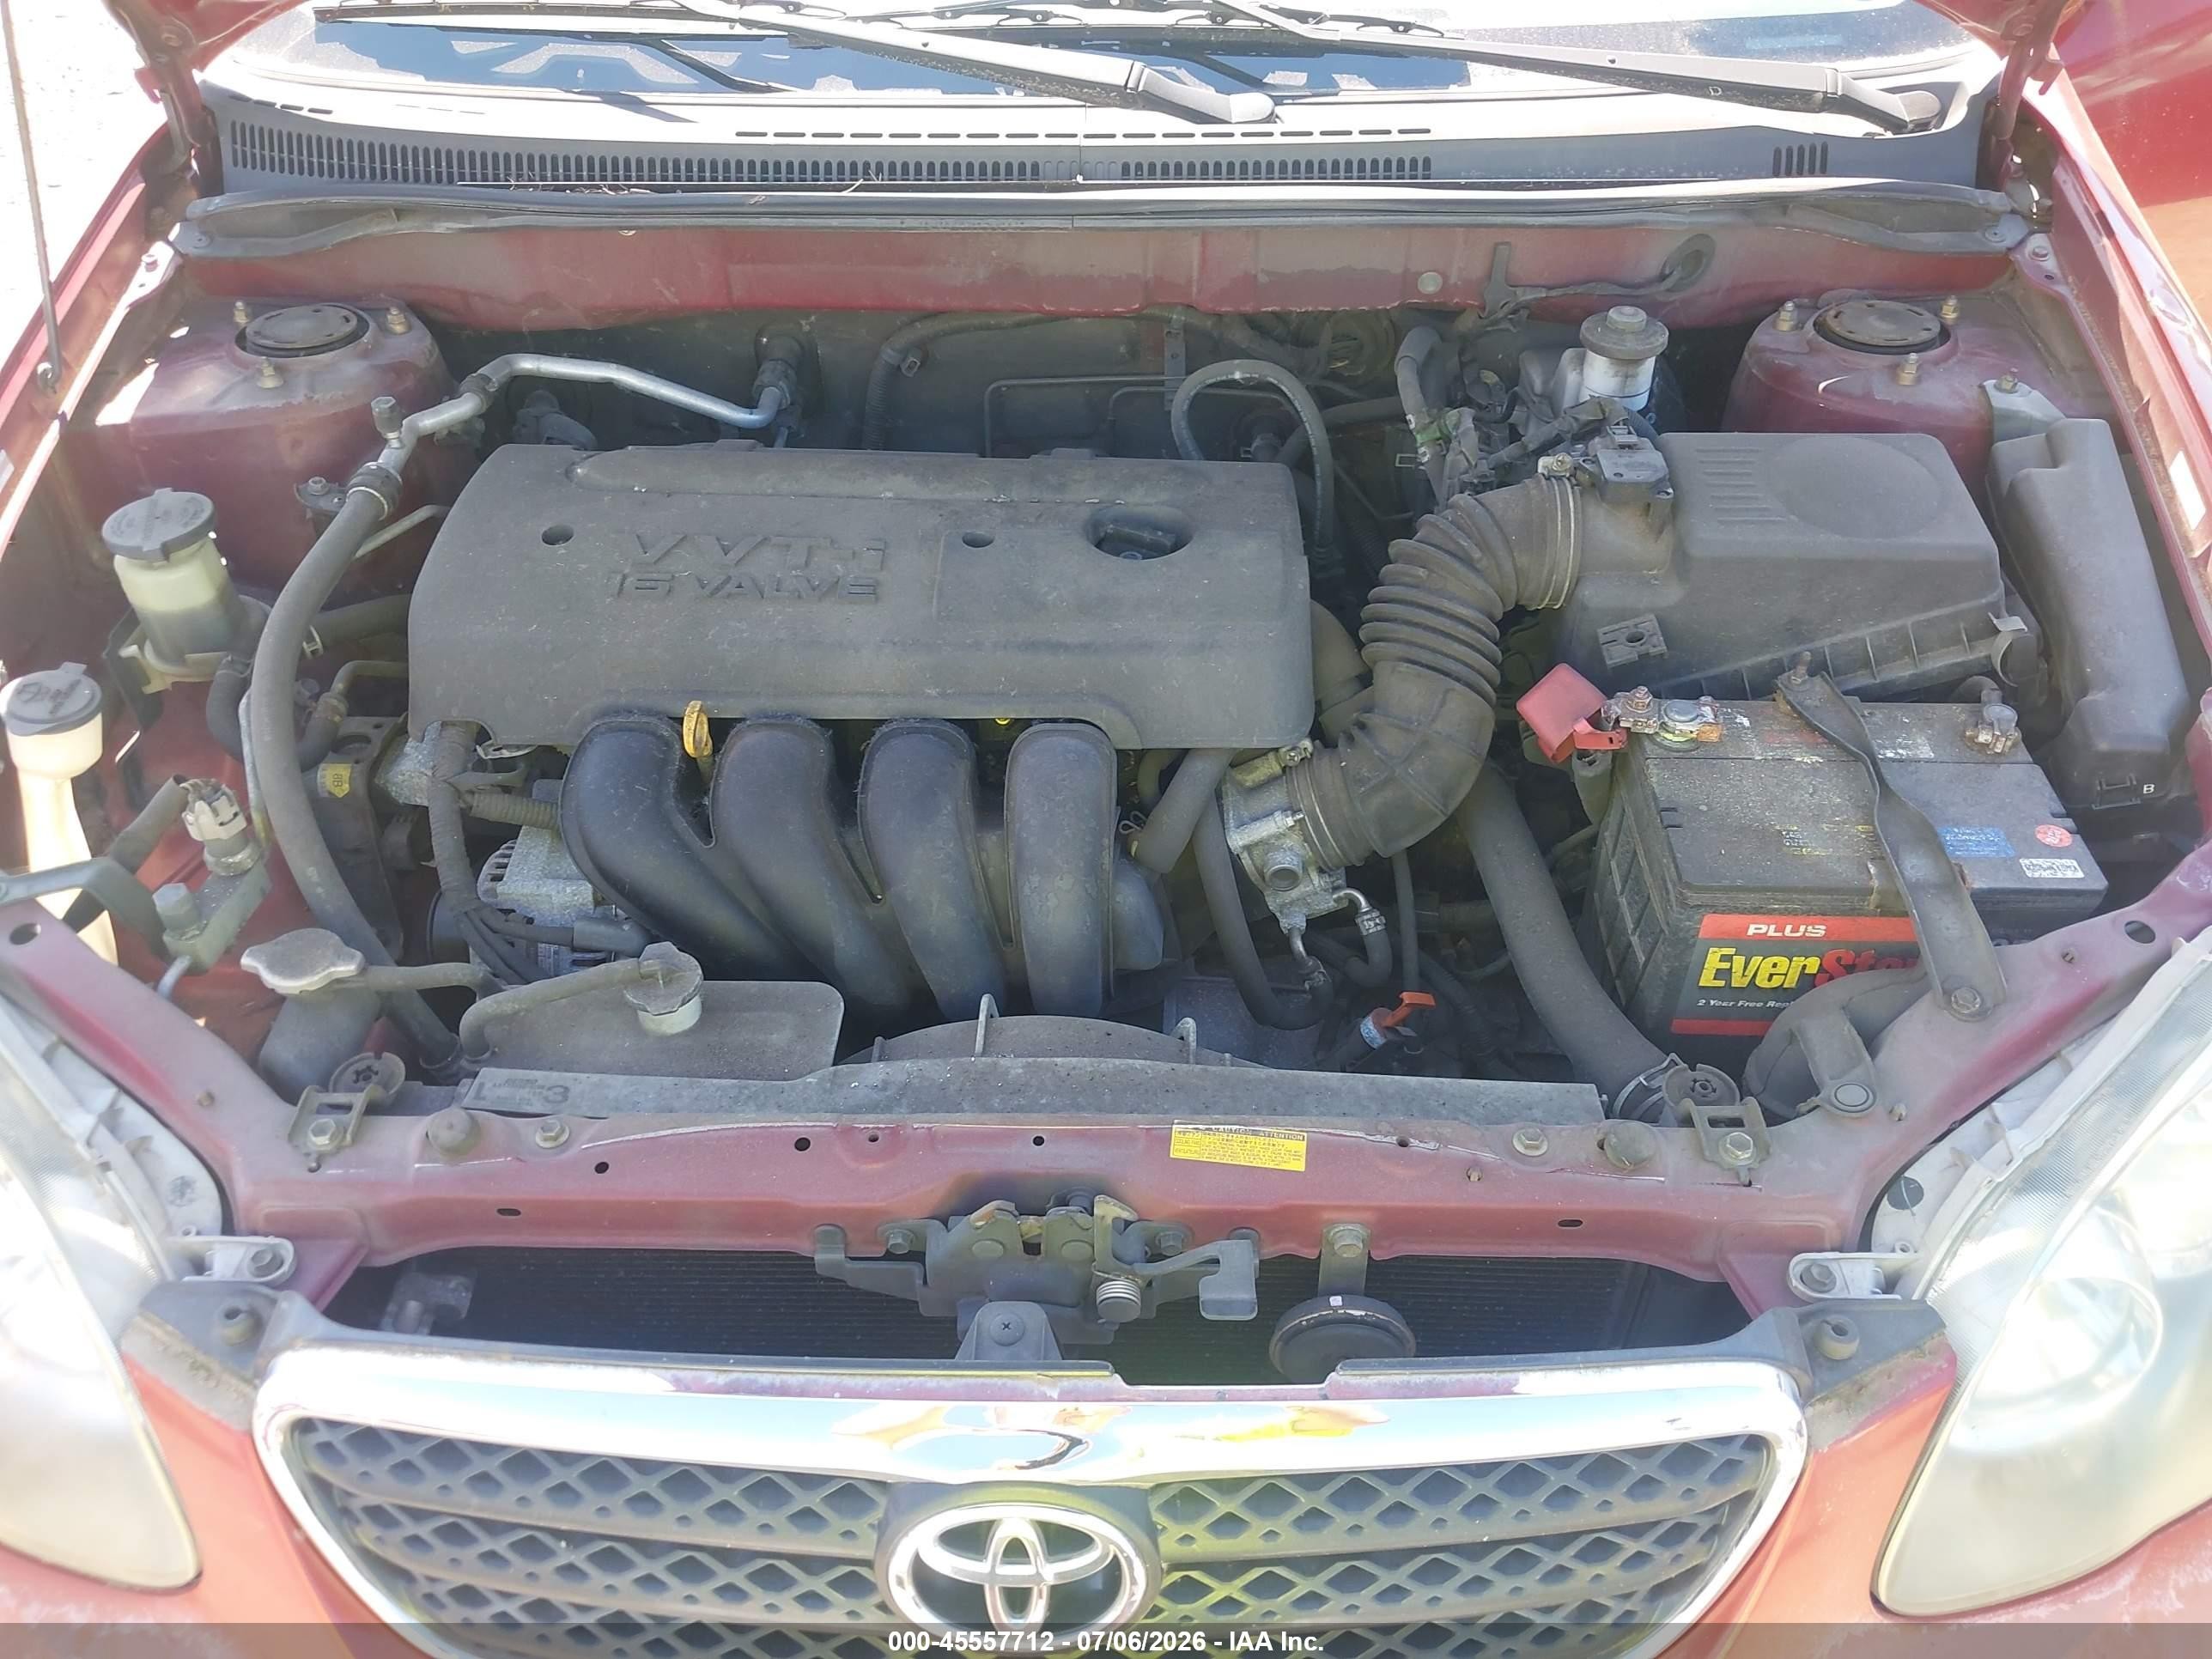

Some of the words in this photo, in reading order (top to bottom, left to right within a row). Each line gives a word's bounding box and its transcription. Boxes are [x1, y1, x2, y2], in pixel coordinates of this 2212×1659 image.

[609, 570, 675, 599] 16
[692, 573, 879, 602] VALVE
[2143, 784, 2154, 794] B
[1746, 923, 1827, 938] PLUS
[1696, 999, 1705, 1007] 2
[1709, 999, 1735, 1008] Year
[1737, 1000, 1764, 1008] Free
[1260, 1131, 1304, 1141] ATTENTION
